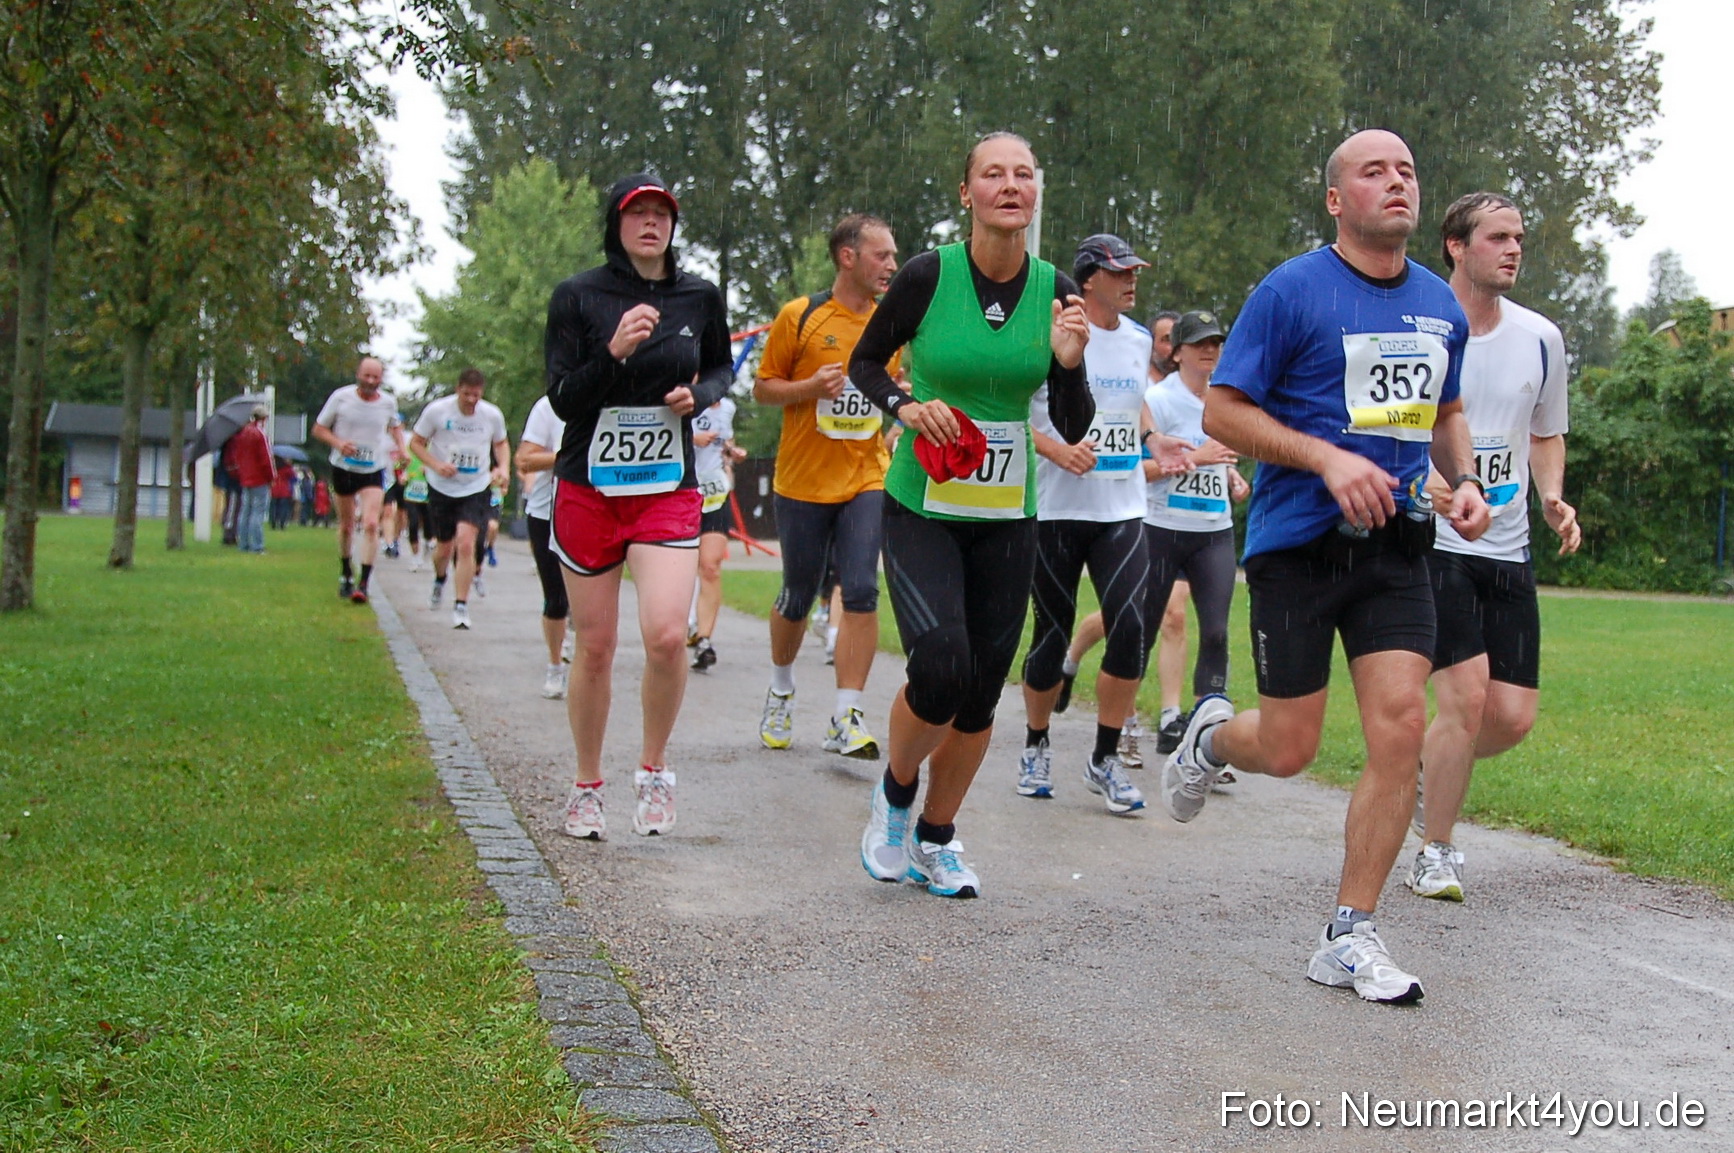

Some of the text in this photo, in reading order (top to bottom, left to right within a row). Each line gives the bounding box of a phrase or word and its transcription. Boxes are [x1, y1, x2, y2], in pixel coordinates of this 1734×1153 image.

[1095, 374, 1139, 390] heinloth
[1369, 362, 1432, 403] 352
[832, 393, 872, 416] 565
[1387, 409, 1422, 425] Marco
[598, 428, 674, 463] 2522
[1088, 427, 1136, 453] 2434
[613, 469, 658, 483] Yvonne
[974, 447, 1014, 483] 07
[1175, 471, 1222, 498] 2436
